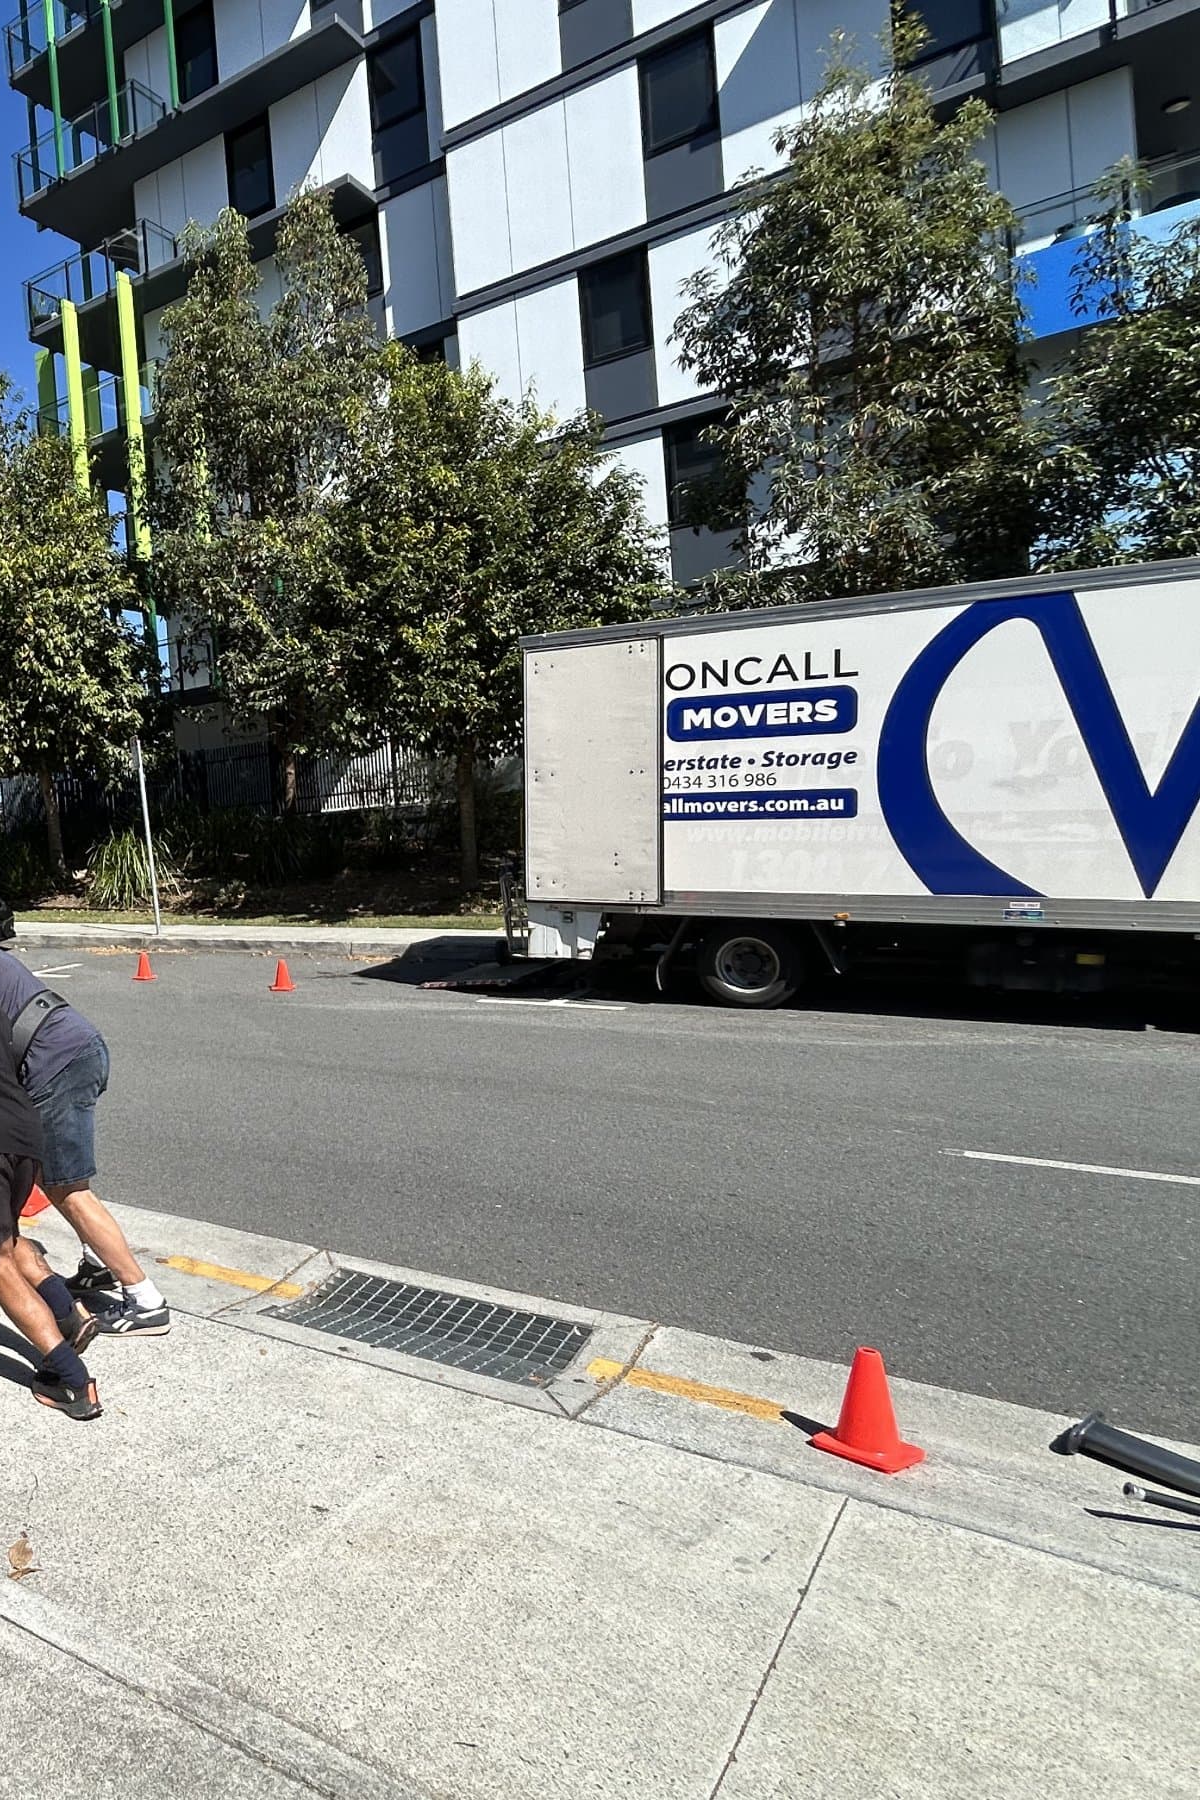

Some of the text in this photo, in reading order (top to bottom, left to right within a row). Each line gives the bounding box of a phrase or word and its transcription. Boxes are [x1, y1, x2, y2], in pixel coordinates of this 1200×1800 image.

[665, 648, 859, 692] ONCALL
[682, 699, 838, 731] MOVERS
[664, 750, 858, 772] erstate Storage
[707, 773, 739, 788] 316
[744, 772, 777, 787] 986
[664, 797, 845, 814] allmovers.com.au
